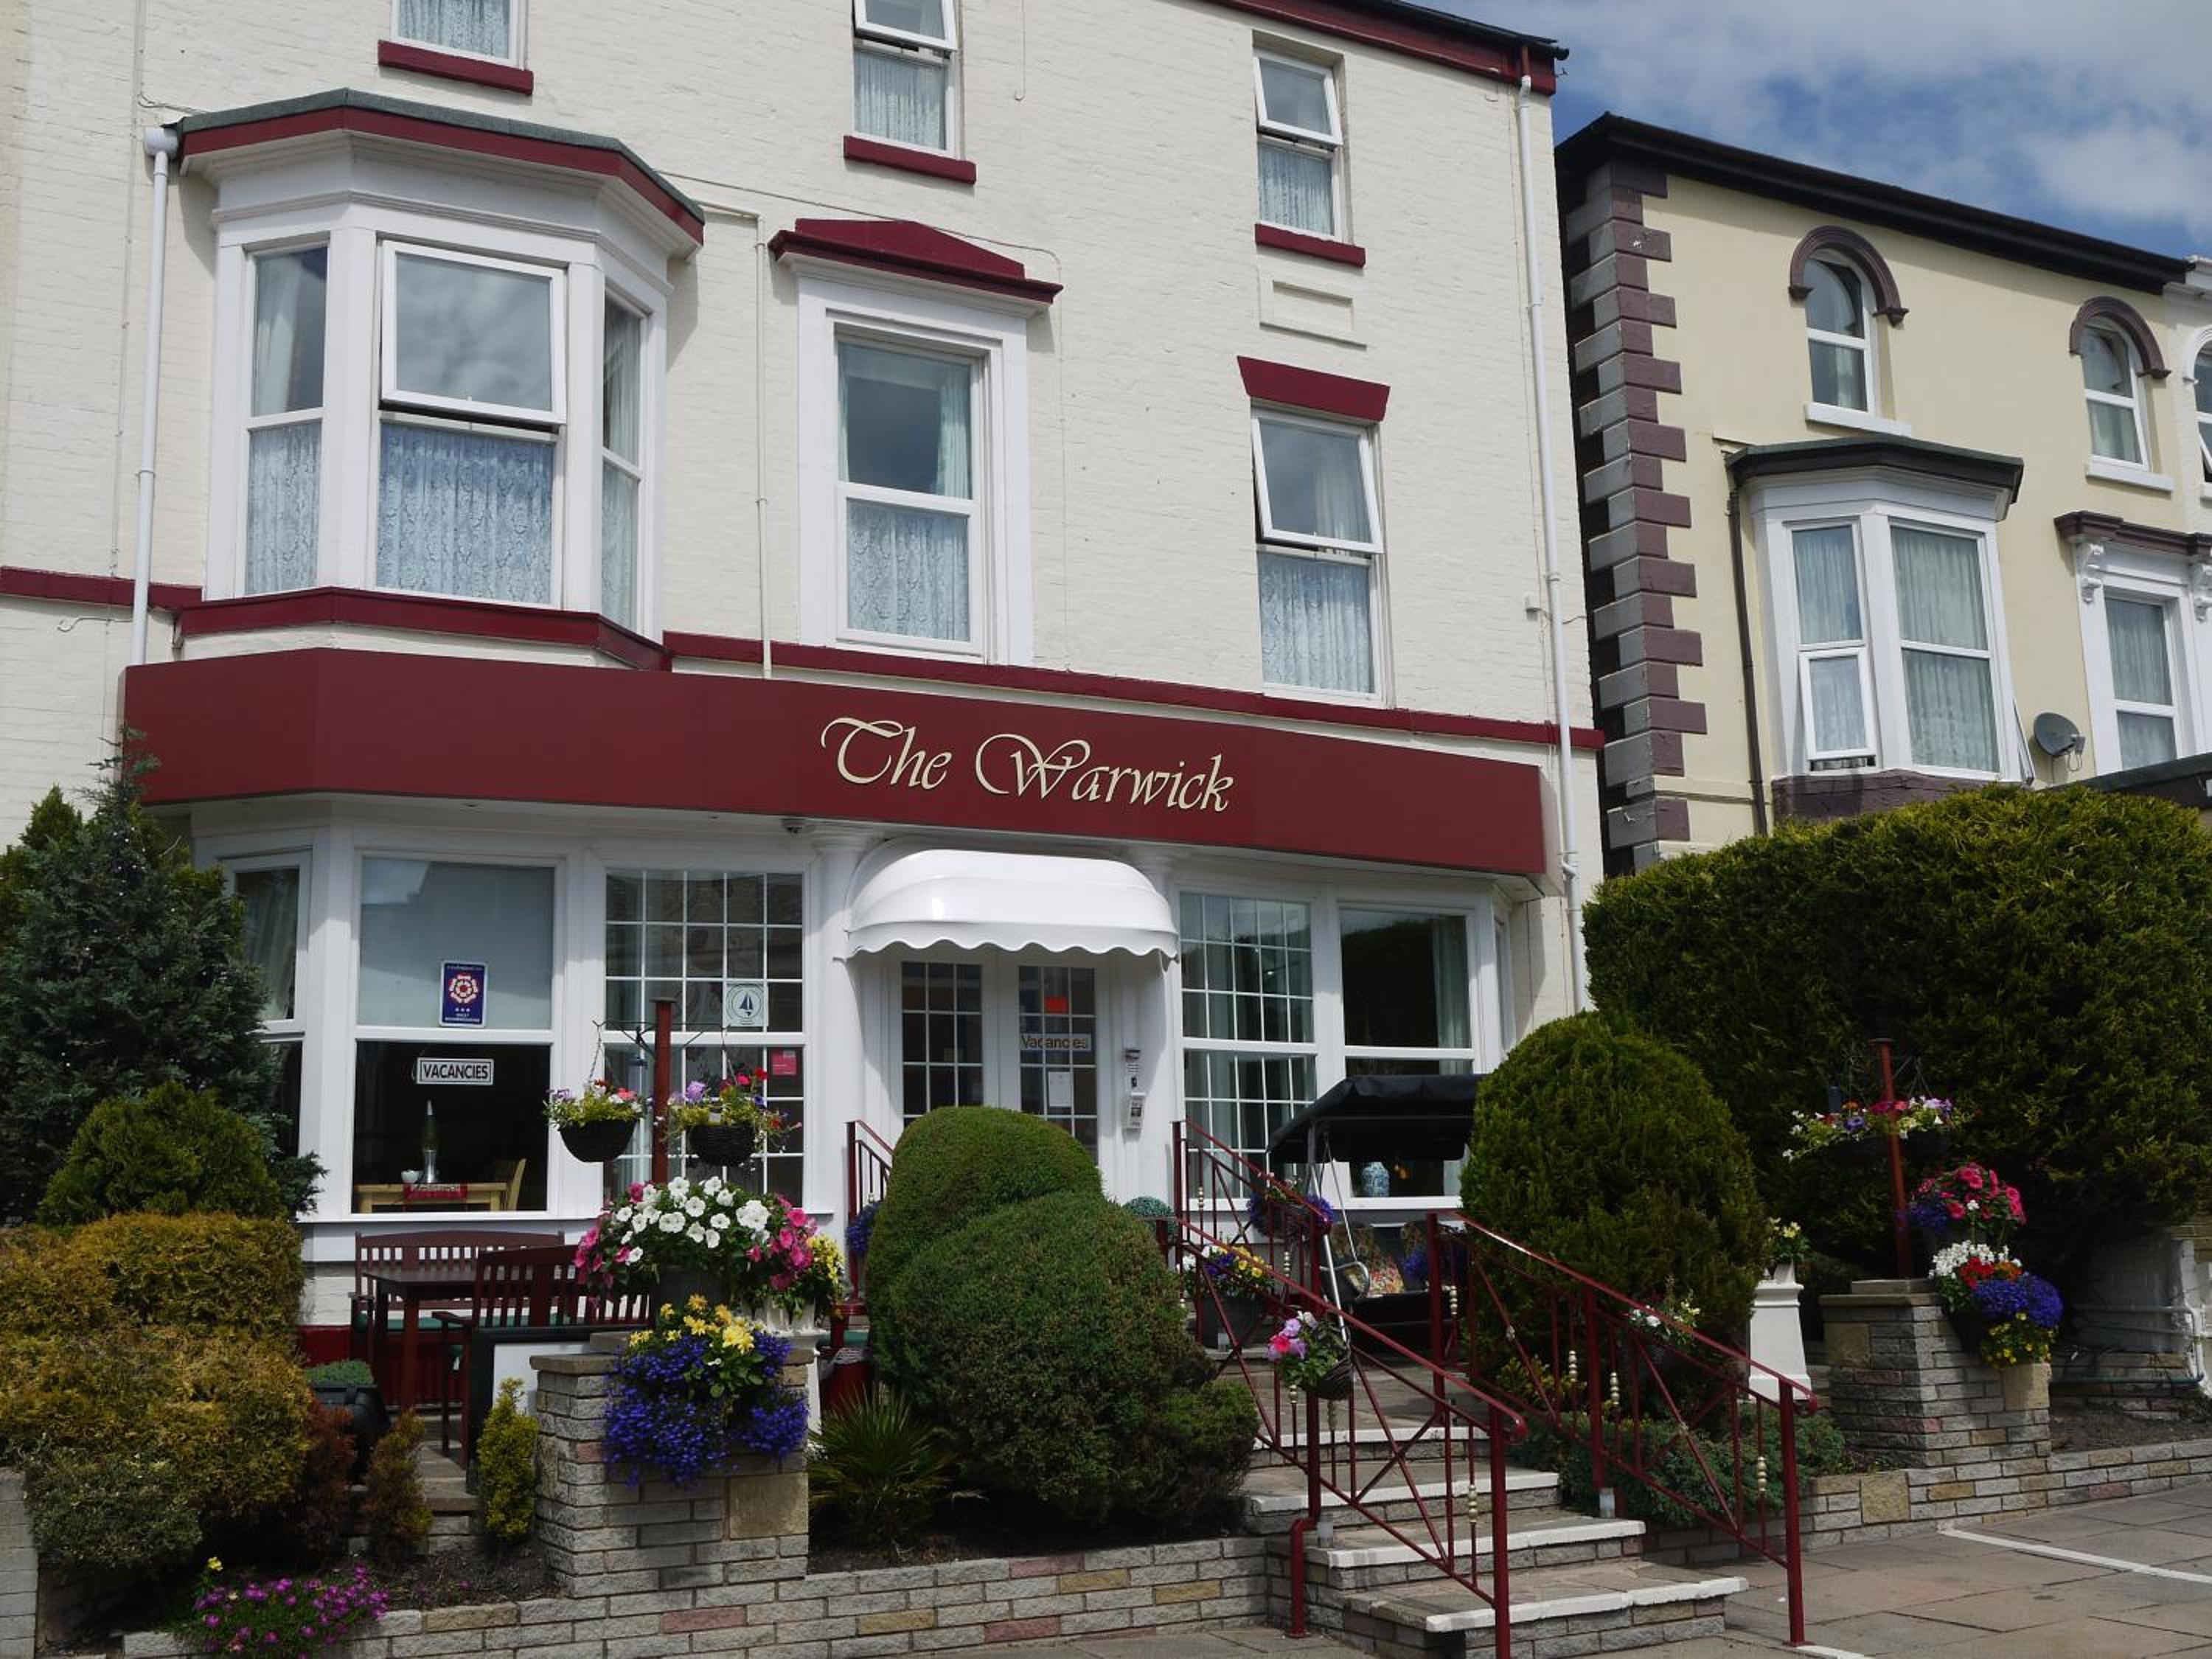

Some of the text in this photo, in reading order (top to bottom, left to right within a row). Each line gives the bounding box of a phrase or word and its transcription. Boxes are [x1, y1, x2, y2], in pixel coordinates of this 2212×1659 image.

[821, 717, 1234, 812] The Warwick
[1021, 1035, 1087, 1049] Vacances
[423, 1064, 489, 1079] VACANCIES
